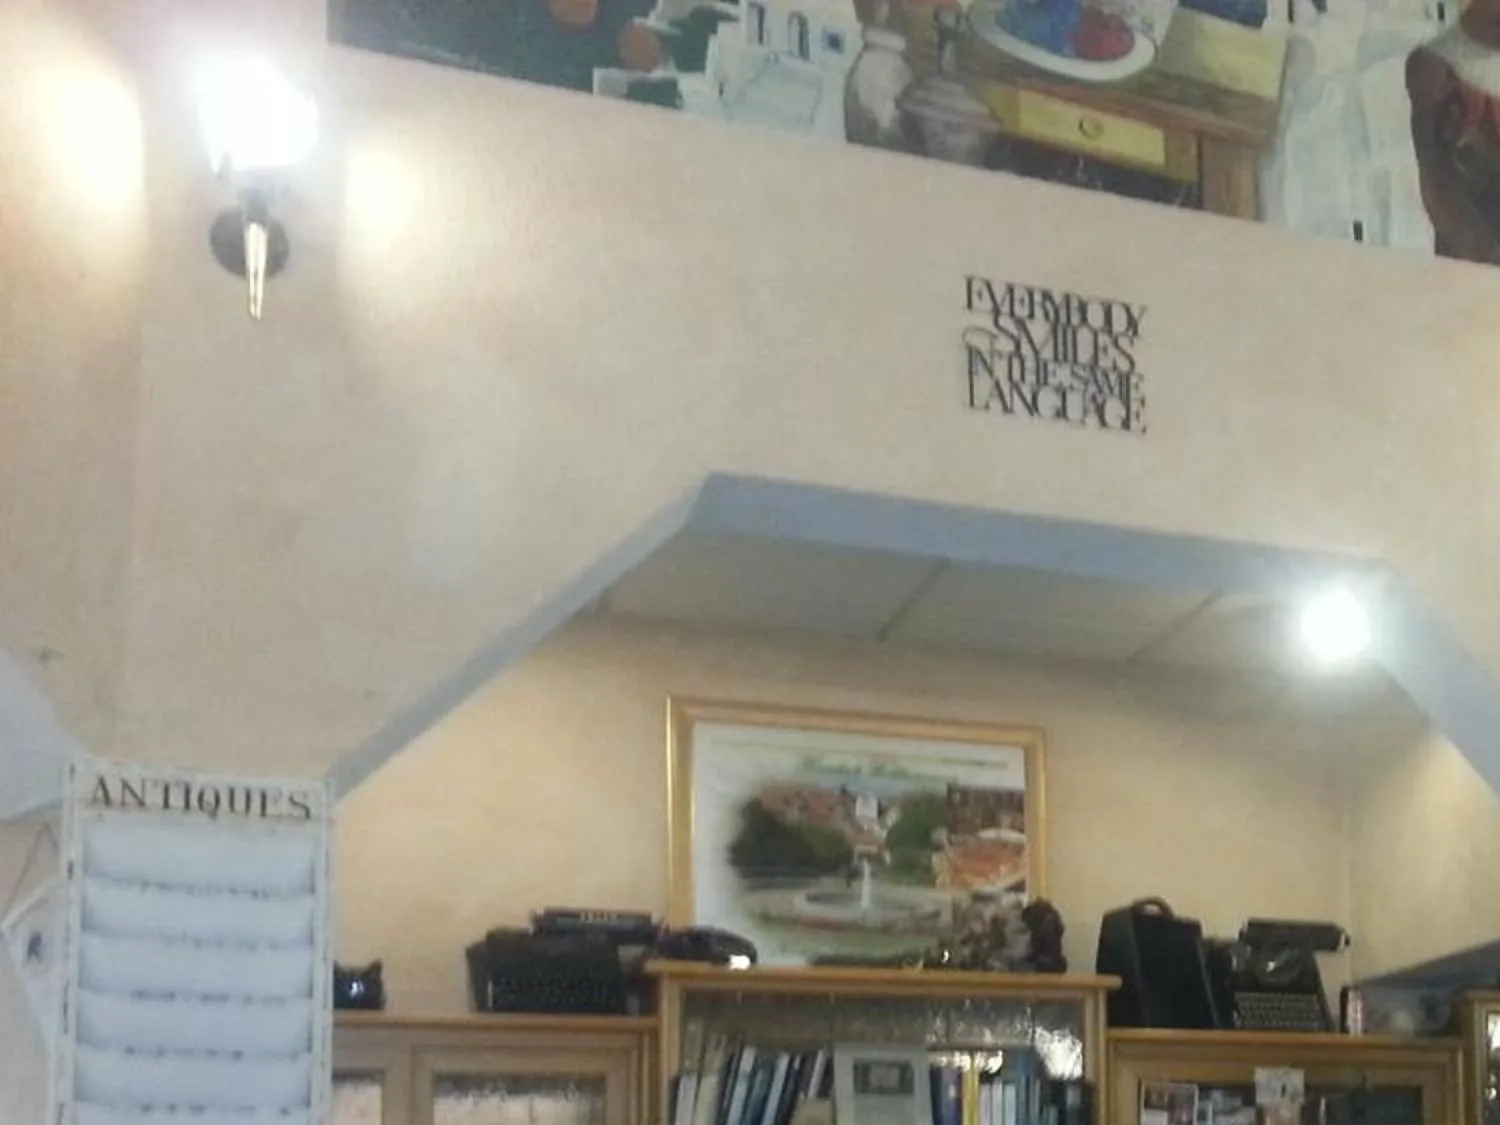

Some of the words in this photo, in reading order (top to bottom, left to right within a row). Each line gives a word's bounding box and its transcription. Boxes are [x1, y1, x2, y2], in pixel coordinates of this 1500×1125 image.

[964, 275, 1148, 338] EVERYBODY
[994, 311, 1137, 374] SMILES
[964, 373, 1148, 435] LANGUAGE
[88, 774, 313, 820] ANTIQUES
